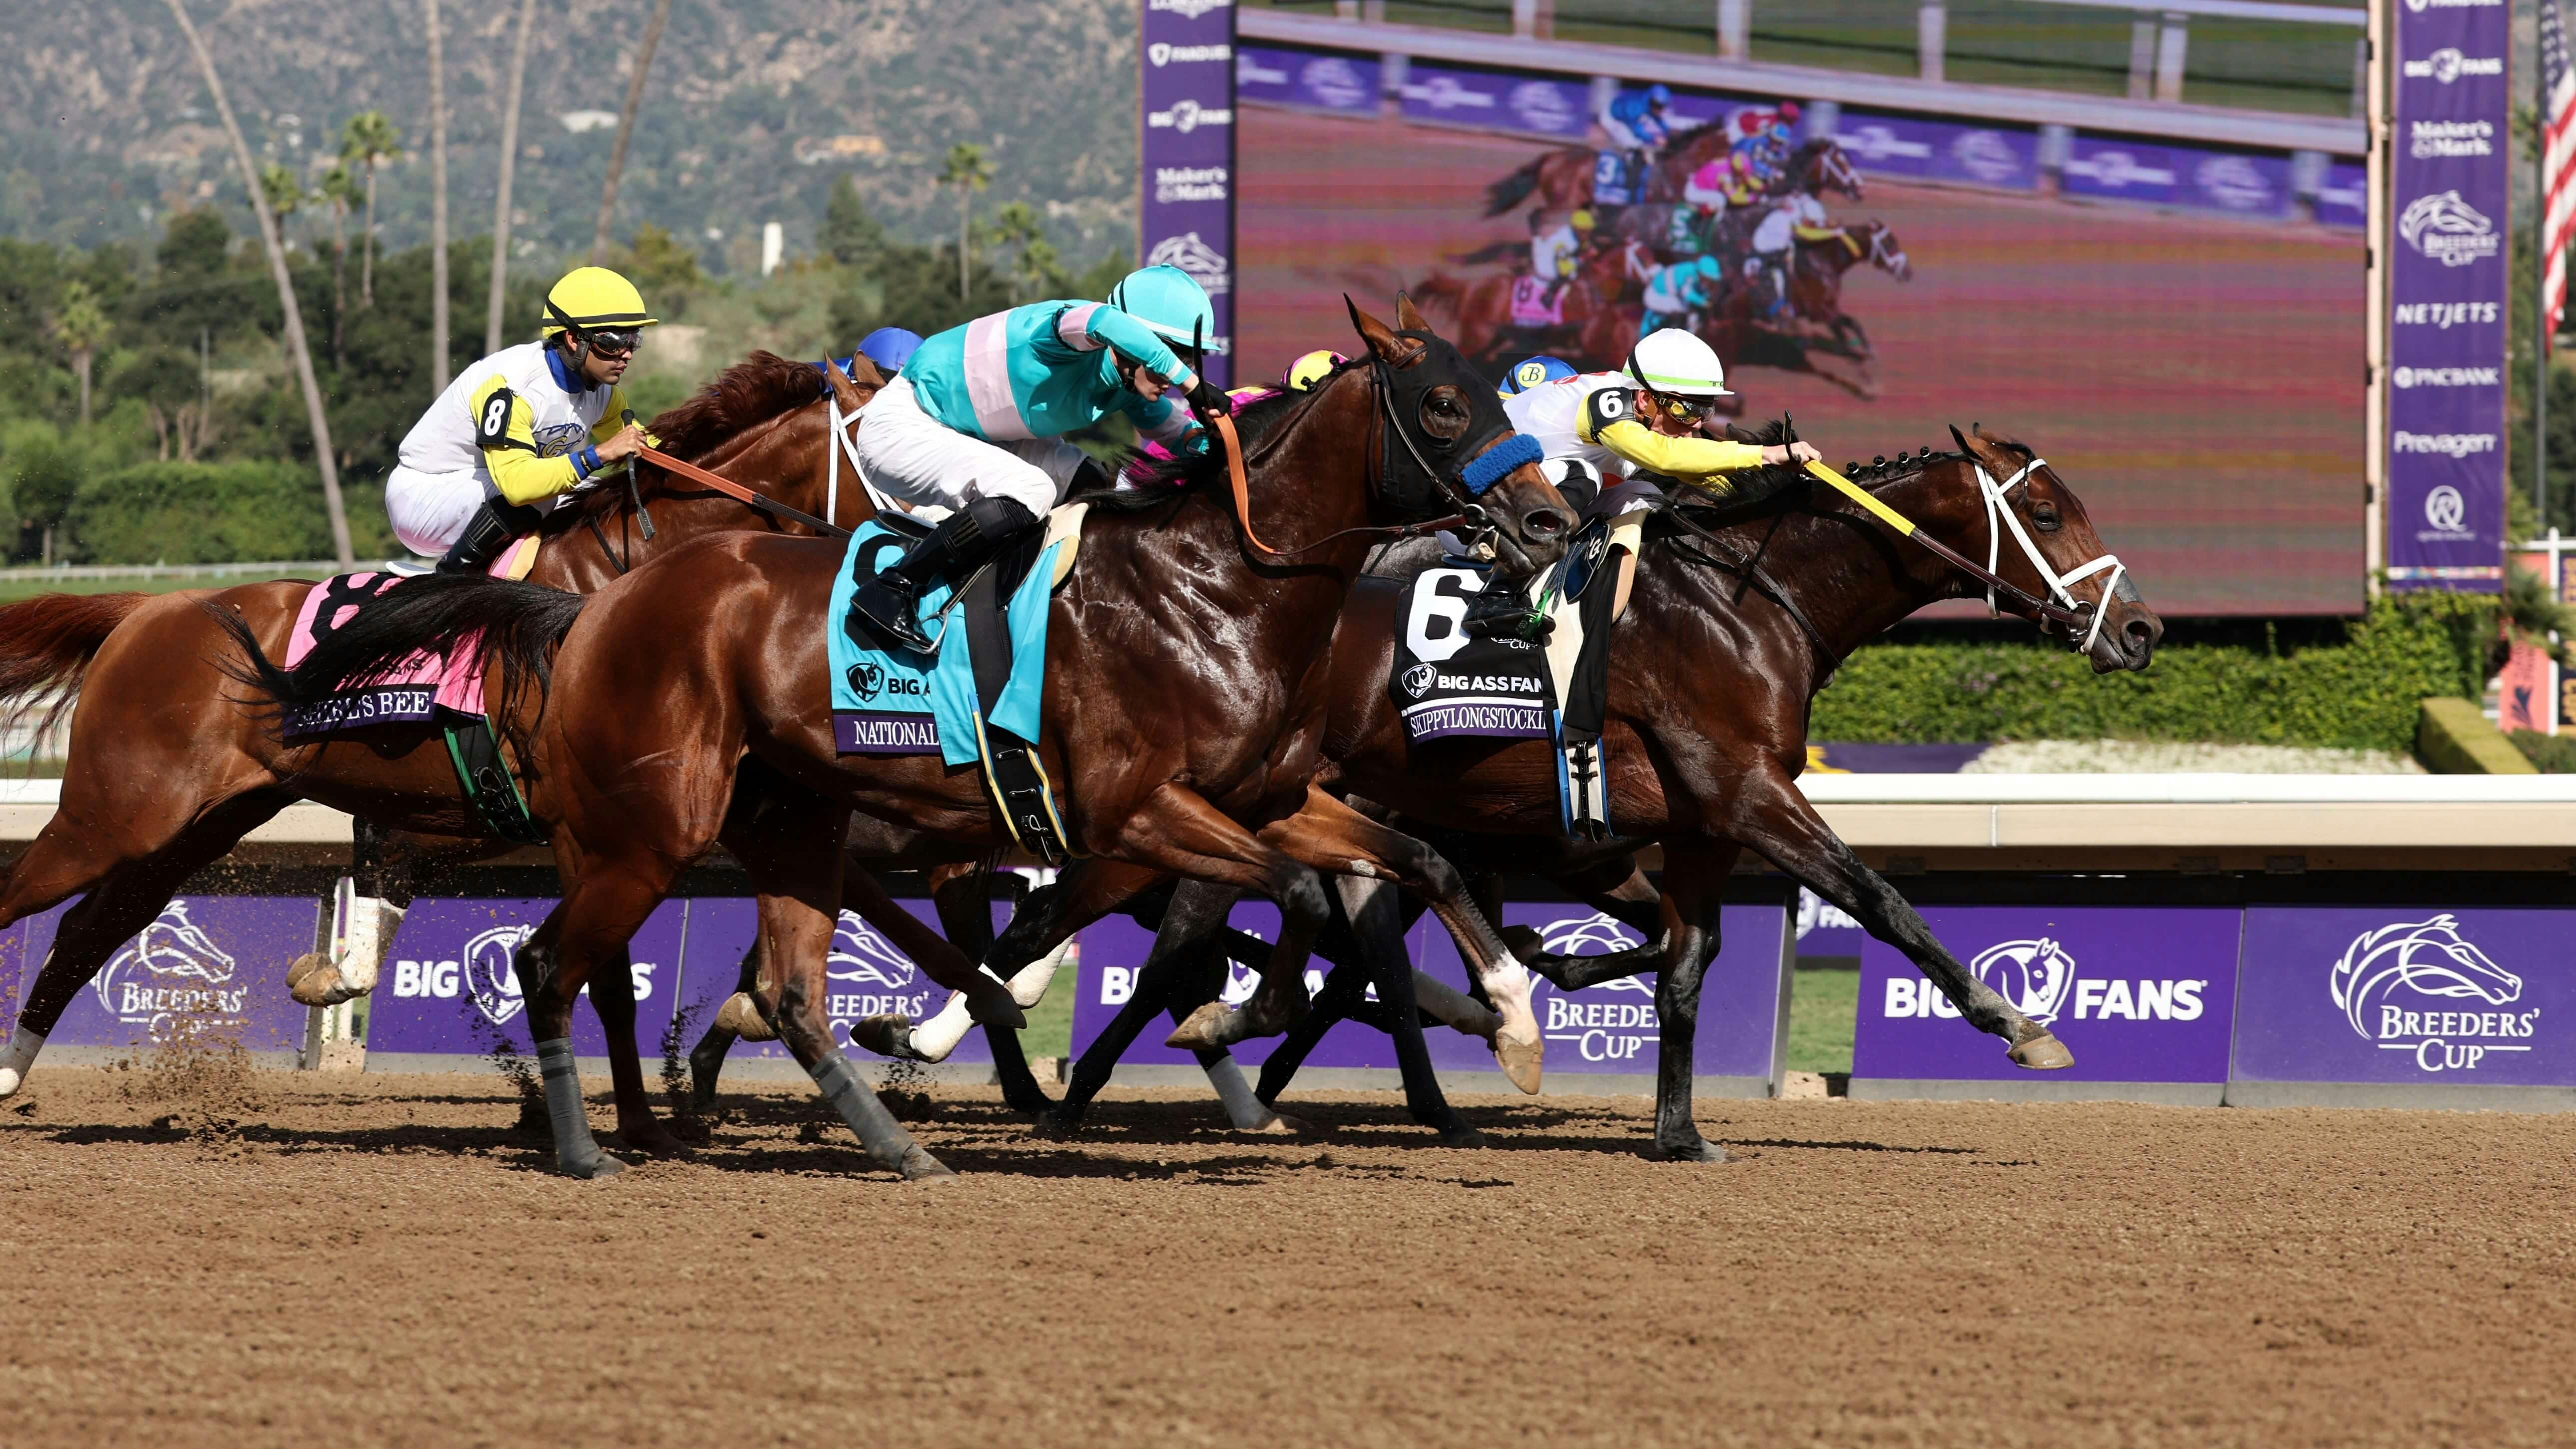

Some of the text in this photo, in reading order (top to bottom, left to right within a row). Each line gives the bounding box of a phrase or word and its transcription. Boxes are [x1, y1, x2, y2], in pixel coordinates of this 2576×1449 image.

[2412, 120, 2493, 138] Maker's
[2433, 137, 2492, 156] Mark
[2395, 302, 2500, 330] NETJETS
[1522, 366, 1540, 382] B
[484, 399, 506, 436] 8
[1599, 391, 1624, 418] 6
[2394, 430, 2497, 458] Prevagen
[1406, 568, 1487, 662] 6
[888, 678, 920, 695] BIG
[1438, 675, 1543, 692] BIG ASS FAN
[378, 691, 430, 715] BEE
[854, 721, 940, 746] NATIONAL
[393, 960, 459, 998] BIG
[1544, 998, 1660, 1030] BREEDE
[2074, 979, 2204, 1021] FANS
[2378, 1005, 2540, 1038] BREEDERS'
[1579, 1029, 1642, 1062] CUP
[2416, 1038, 2484, 1072] CUP
